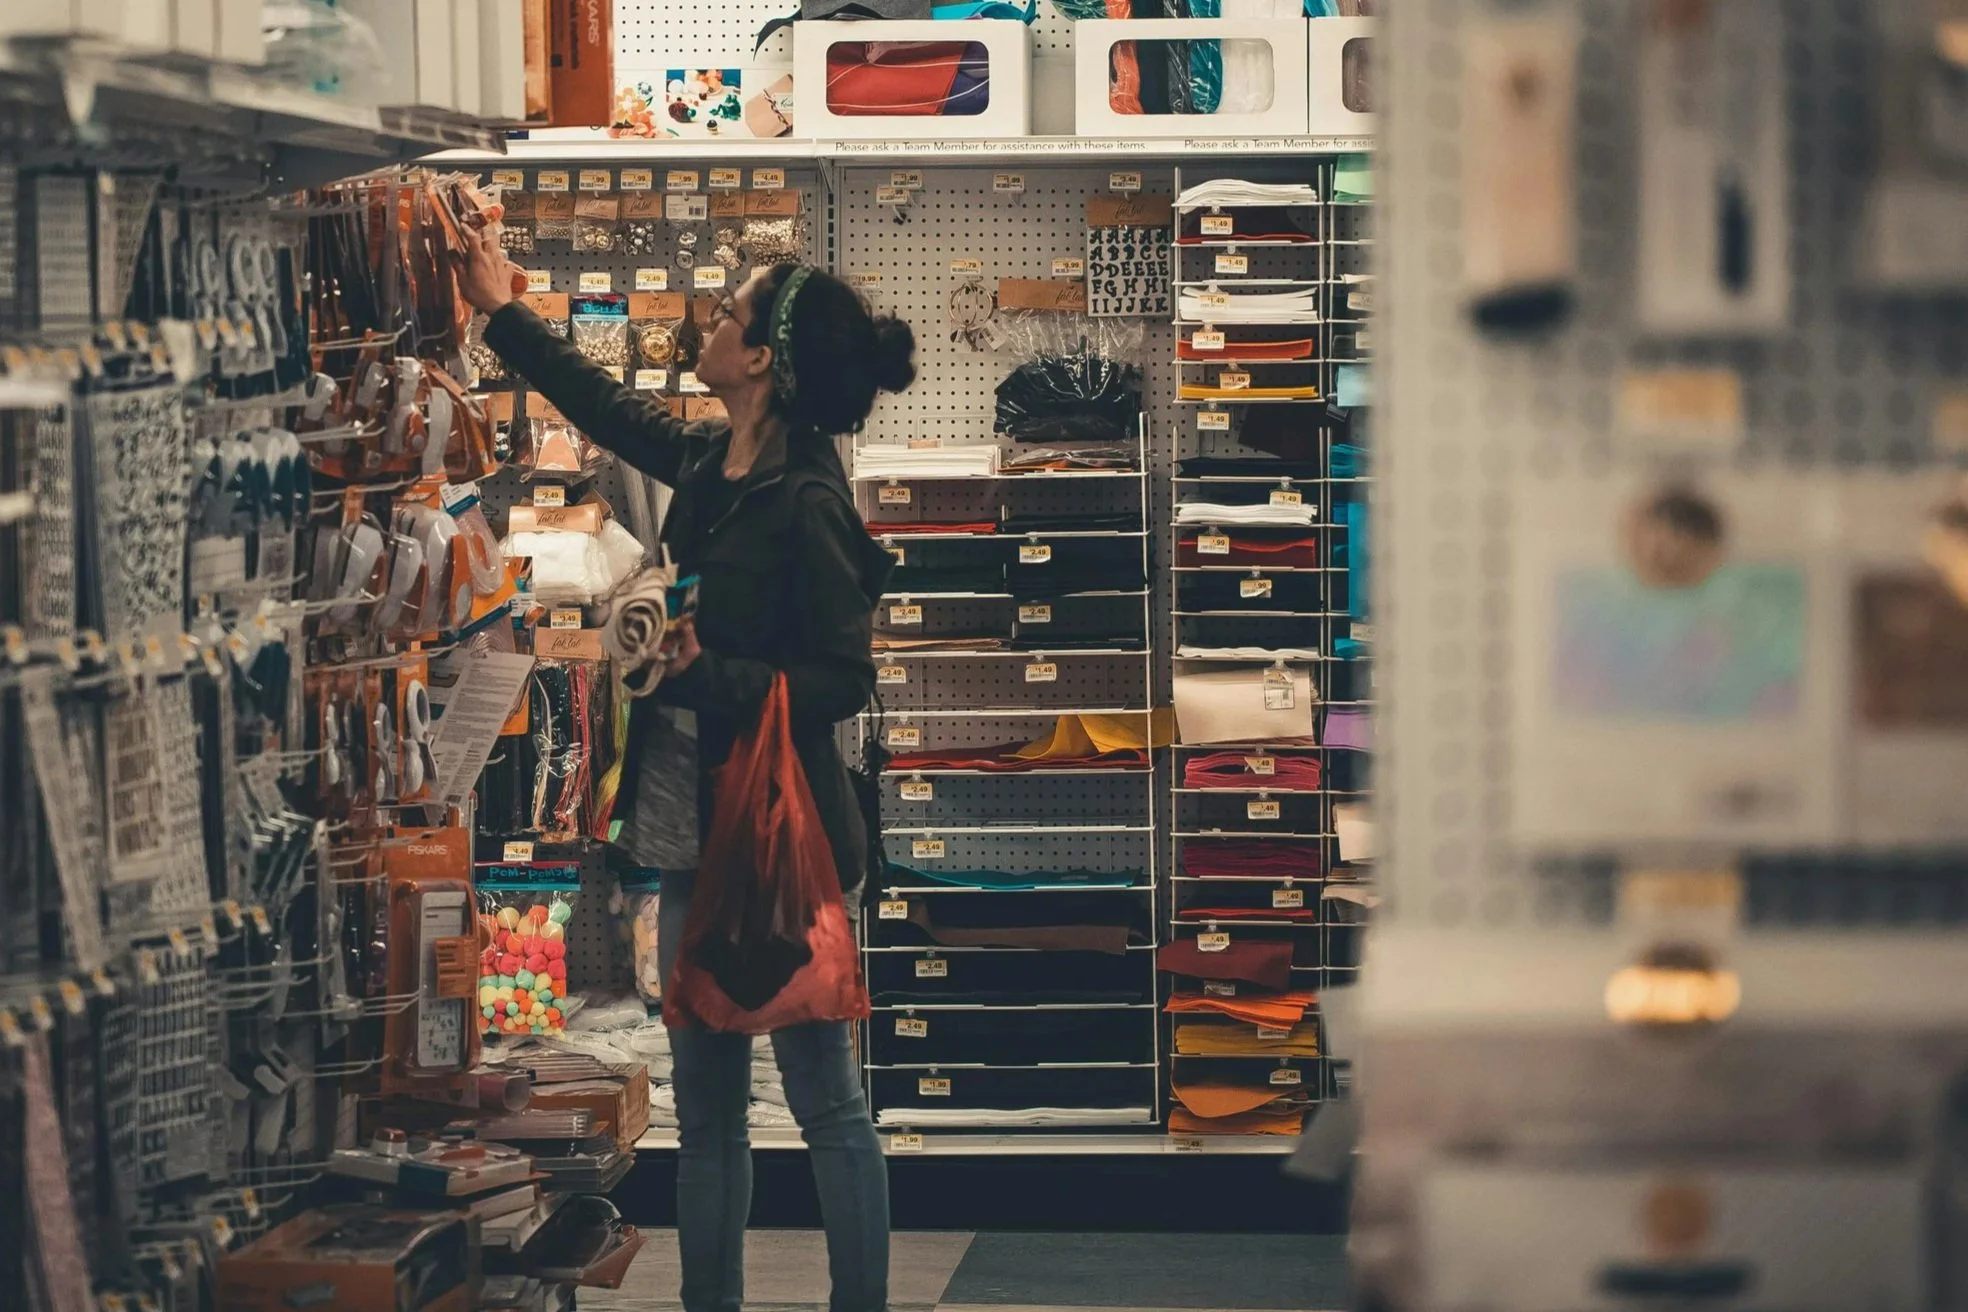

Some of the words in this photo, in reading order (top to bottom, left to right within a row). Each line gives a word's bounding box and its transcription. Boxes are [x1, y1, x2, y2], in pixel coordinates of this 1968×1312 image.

[836, 142, 868, 151] Please
[872, 142, 888, 150] ask
[903, 142, 930, 150] Team
[934, 141, 980, 150] Member
[983, 140, 996, 150] for
[1000, 140, 1054, 150] assistance
[1058, 140, 1080, 150] with
[1084, 140, 1113, 150] these
[1184, 139, 1218, 149] Please
[1222, 139, 1238, 148] ask
[1252, 138, 1279, 148] Team
[1284, 138, 1328, 148] Member
[1333, 138, 1346, 148] for
[408, 844, 448, 855] FISKARS
